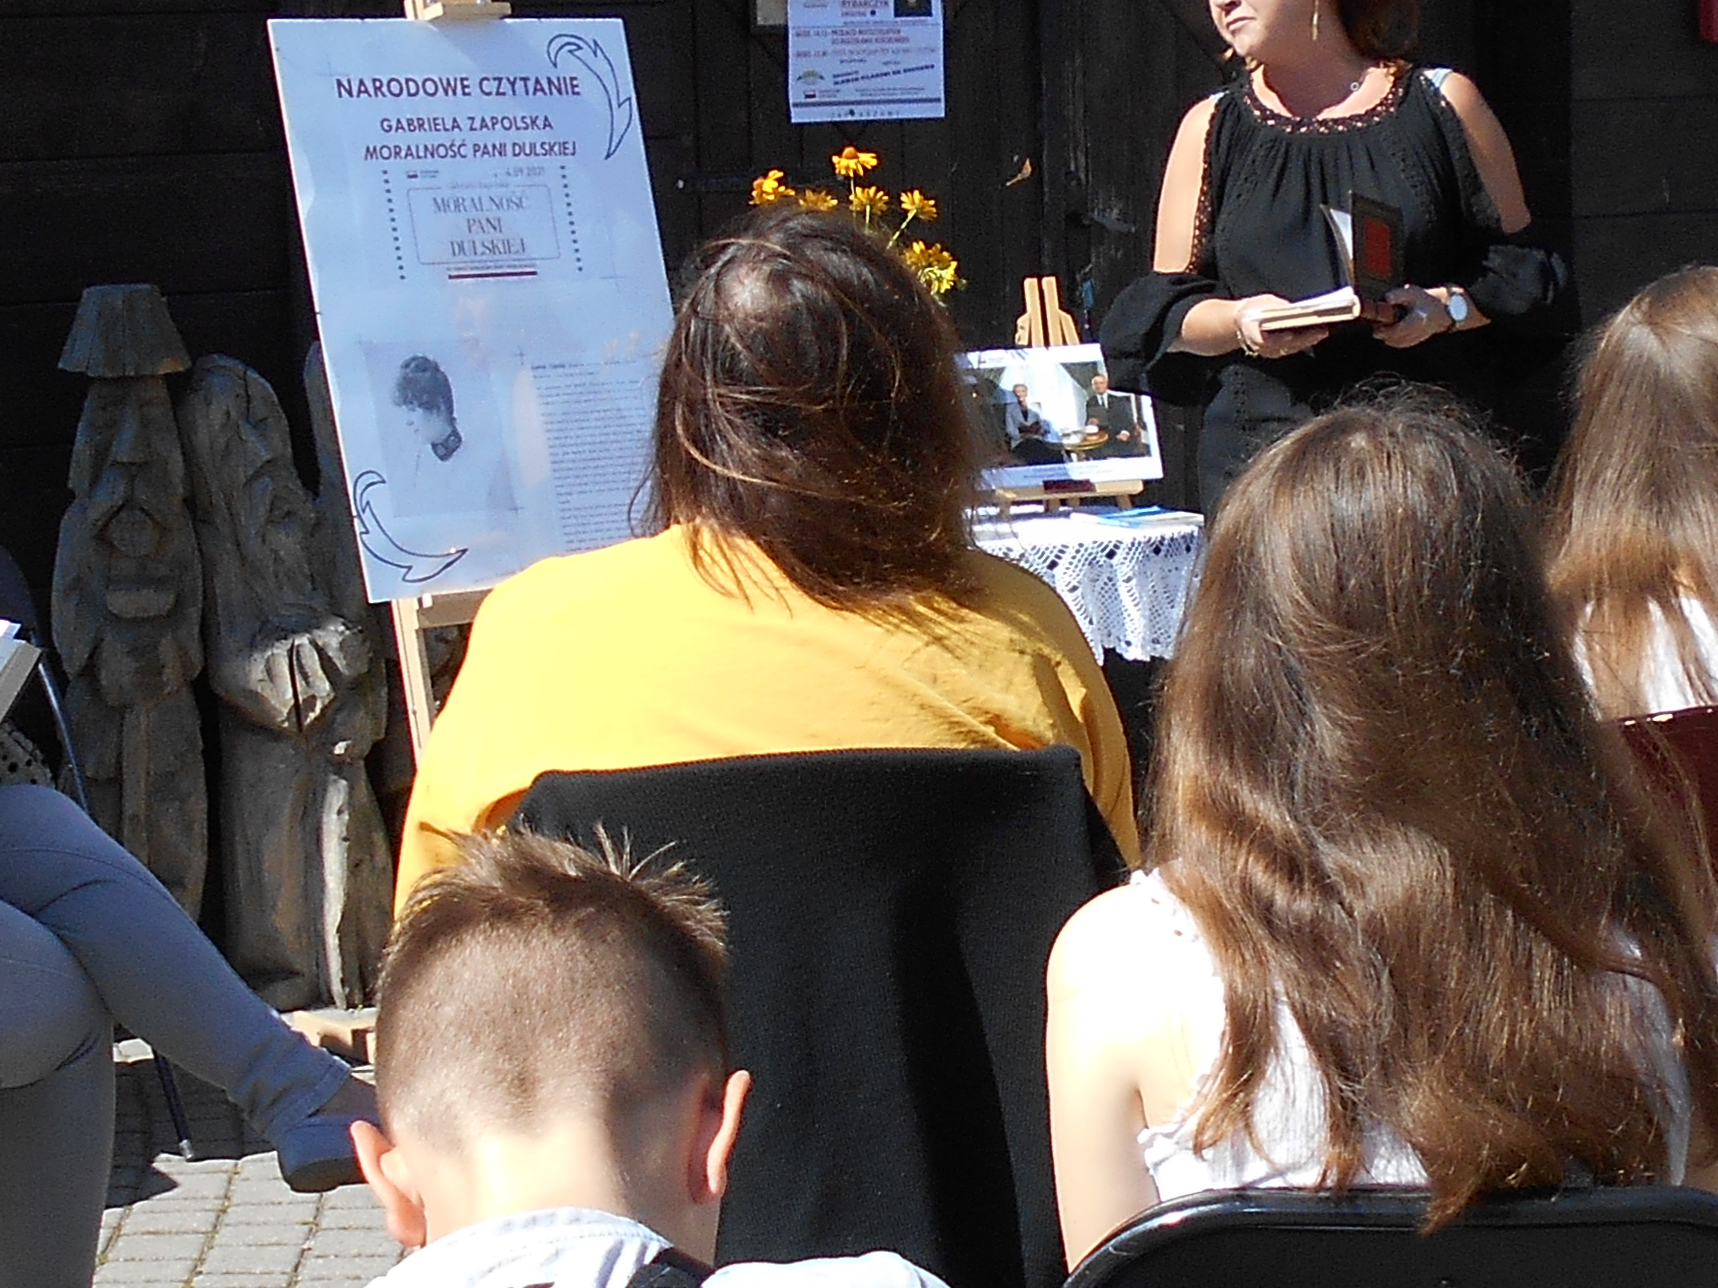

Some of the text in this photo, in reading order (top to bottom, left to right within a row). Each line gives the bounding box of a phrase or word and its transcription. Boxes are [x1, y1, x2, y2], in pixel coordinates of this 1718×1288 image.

[335, 75, 582, 100] NARODOWE CZYTANIE
[379, 115, 554, 134] GABRIELA ZAPOLSKA
[364, 139, 578, 162] MORALNOŚĆ PANI DULSKIEJ
[432, 189, 531, 215] MORALNOŚĆ
[466, 216, 504, 235] PANI
[449, 237, 527, 258] DULSKIEJ
